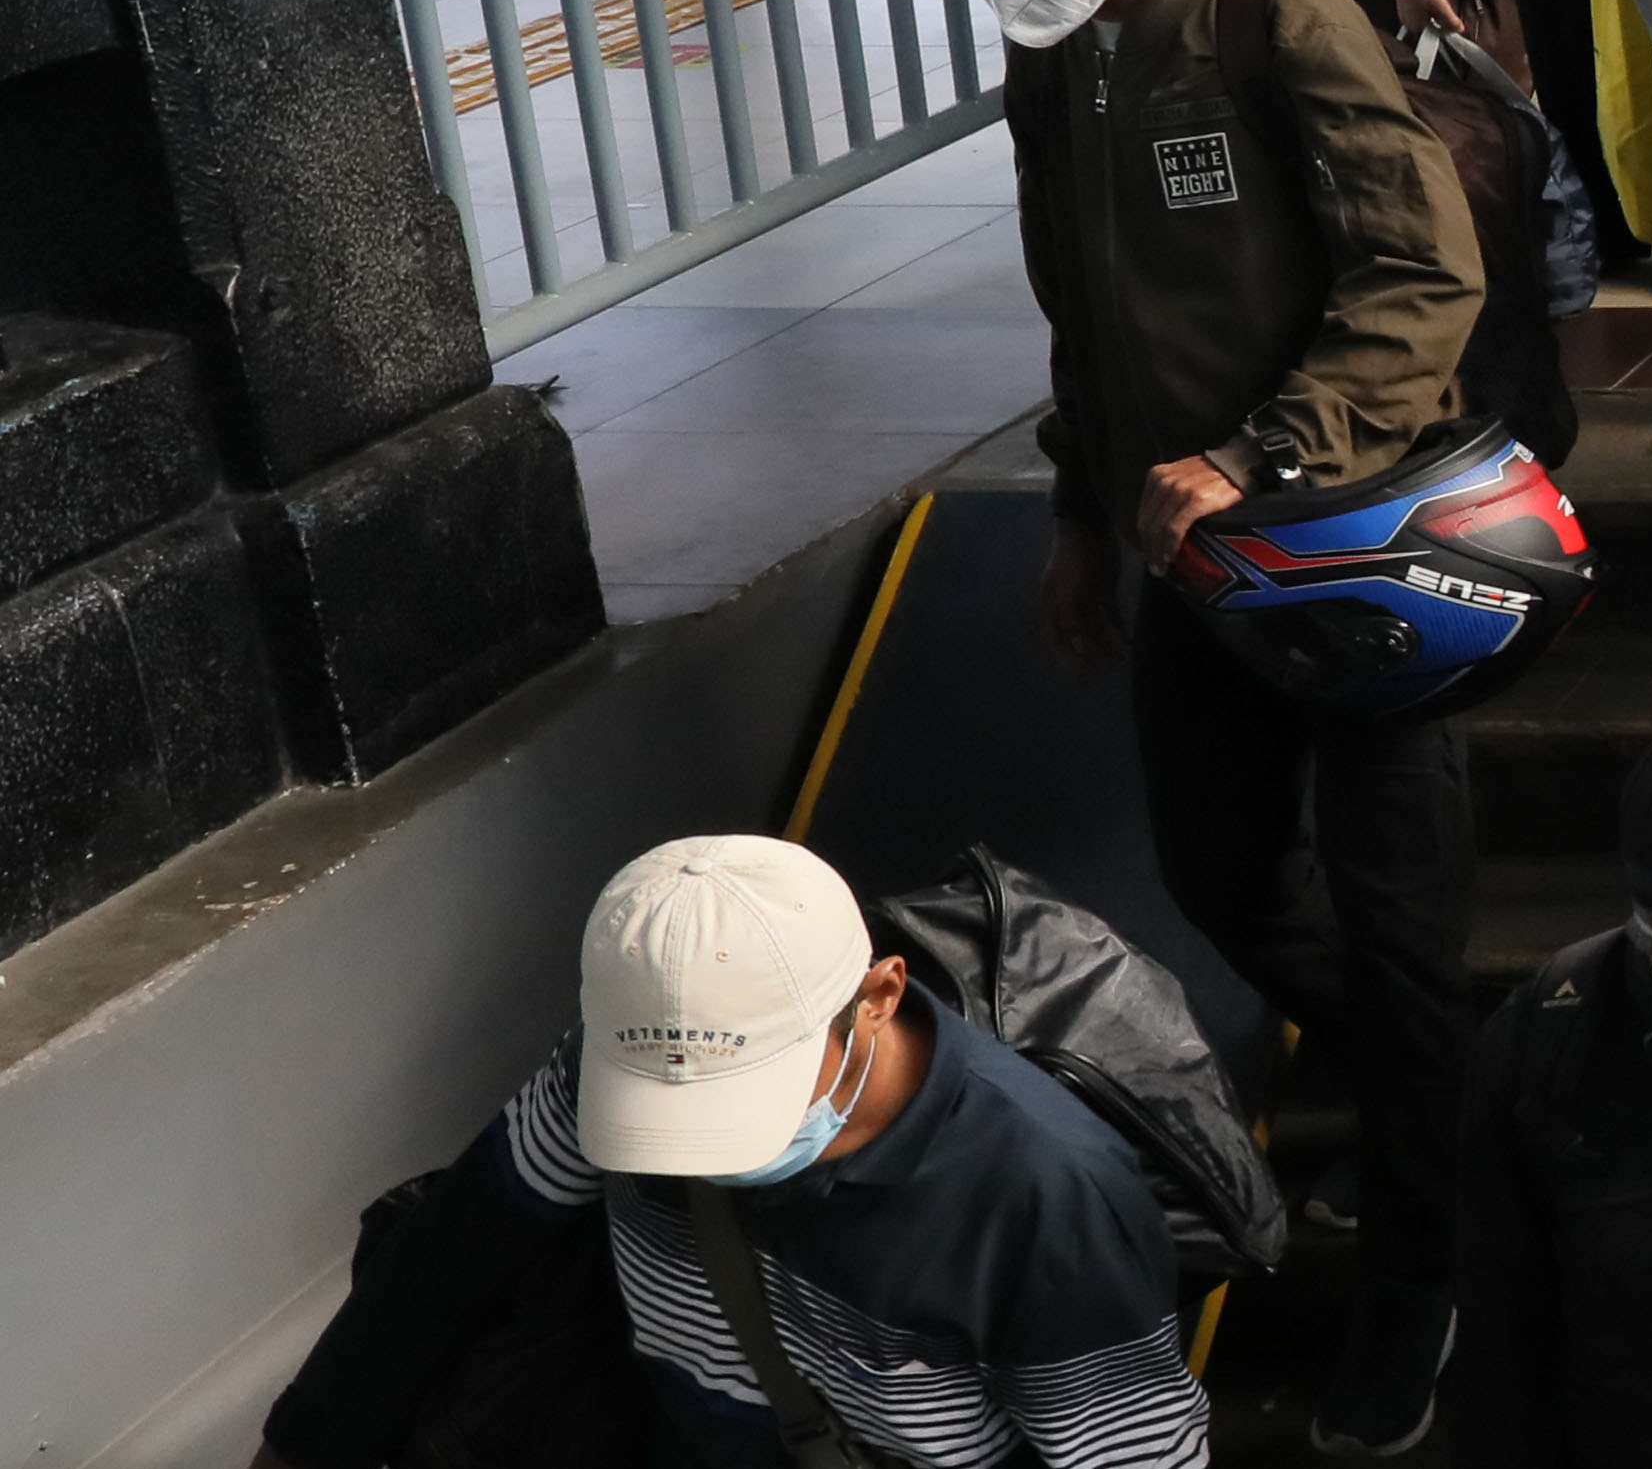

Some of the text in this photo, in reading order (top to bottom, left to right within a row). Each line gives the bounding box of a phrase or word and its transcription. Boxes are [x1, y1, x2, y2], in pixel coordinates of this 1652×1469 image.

[1164, 150, 1224, 172] NINE
[1168, 170, 1226, 198] EIGHT
[616, 1027, 746, 1047] VETEMENTS
